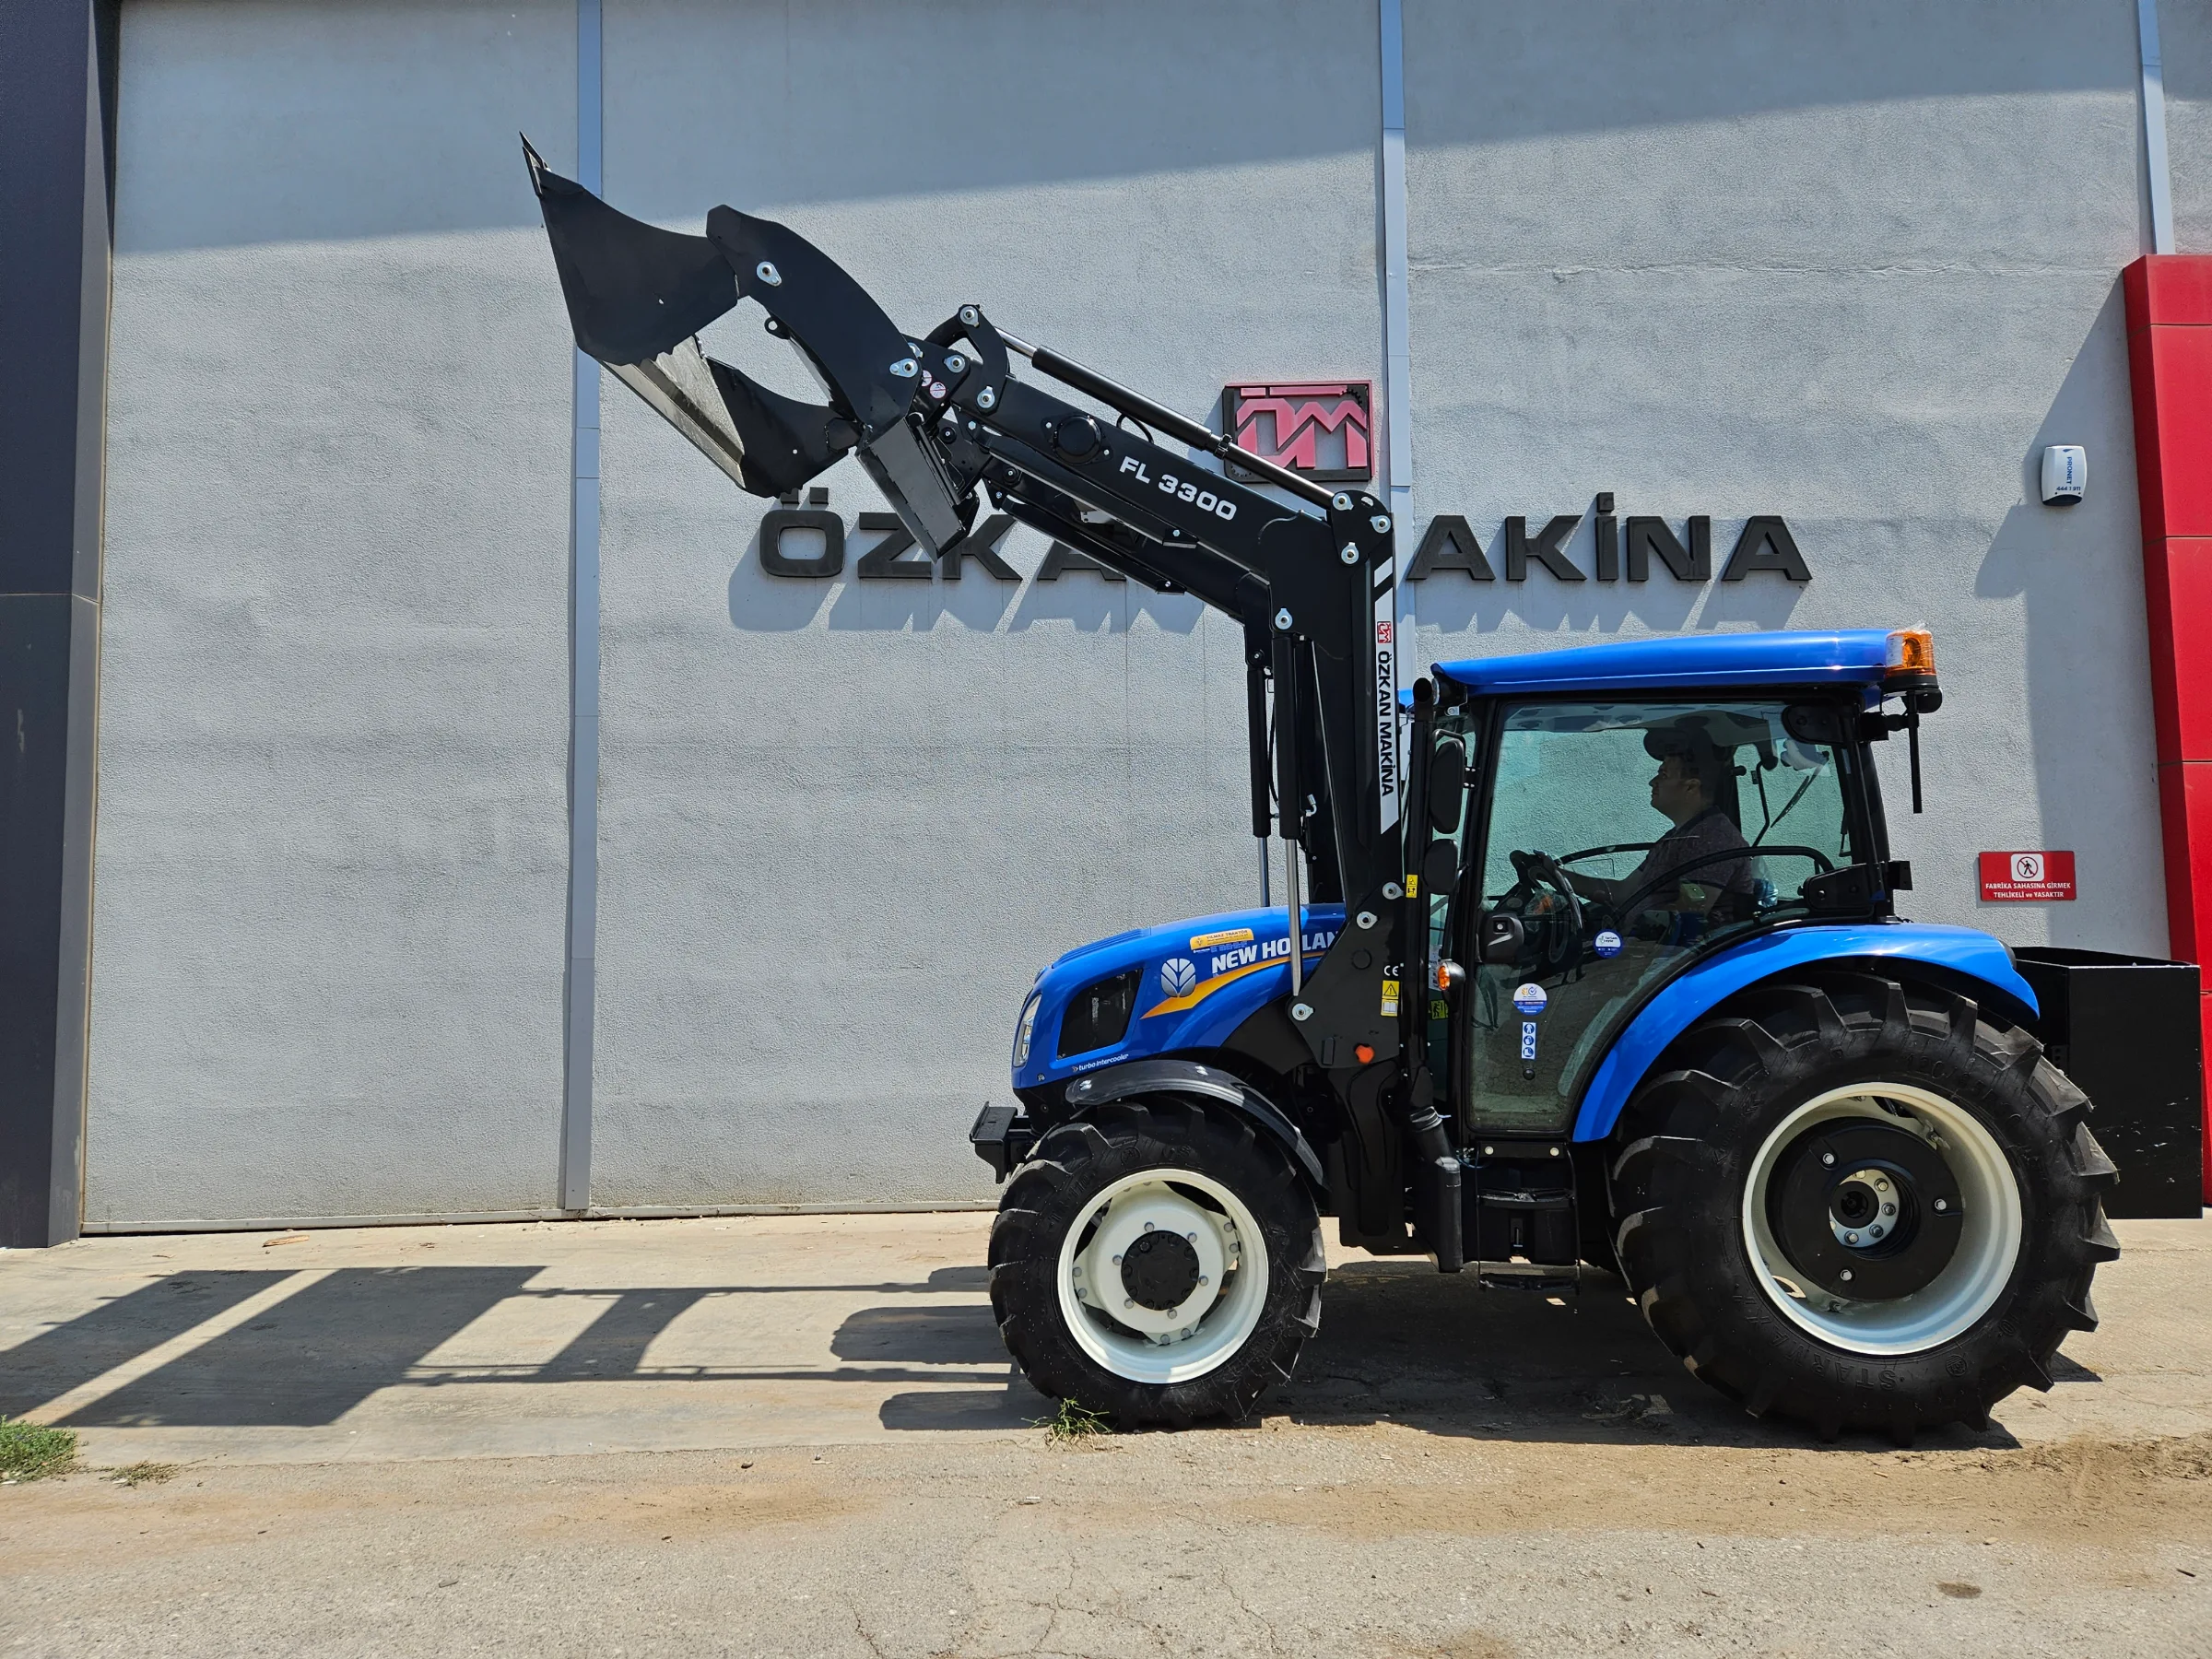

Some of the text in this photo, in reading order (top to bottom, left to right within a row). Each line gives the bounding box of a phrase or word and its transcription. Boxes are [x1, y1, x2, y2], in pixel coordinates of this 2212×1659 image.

[1119, 455, 1238, 522] FL 3300
[759, 487, 1814, 582] ÖZKA AKİNA
[1378, 650, 1396, 797] ÖZKAN MAKİNA
[2046, 881, 2071, 889] GİRMEK
[1211, 944, 1258, 974] NEW
[1078, 1053, 1129, 1071] turbo intercooler
